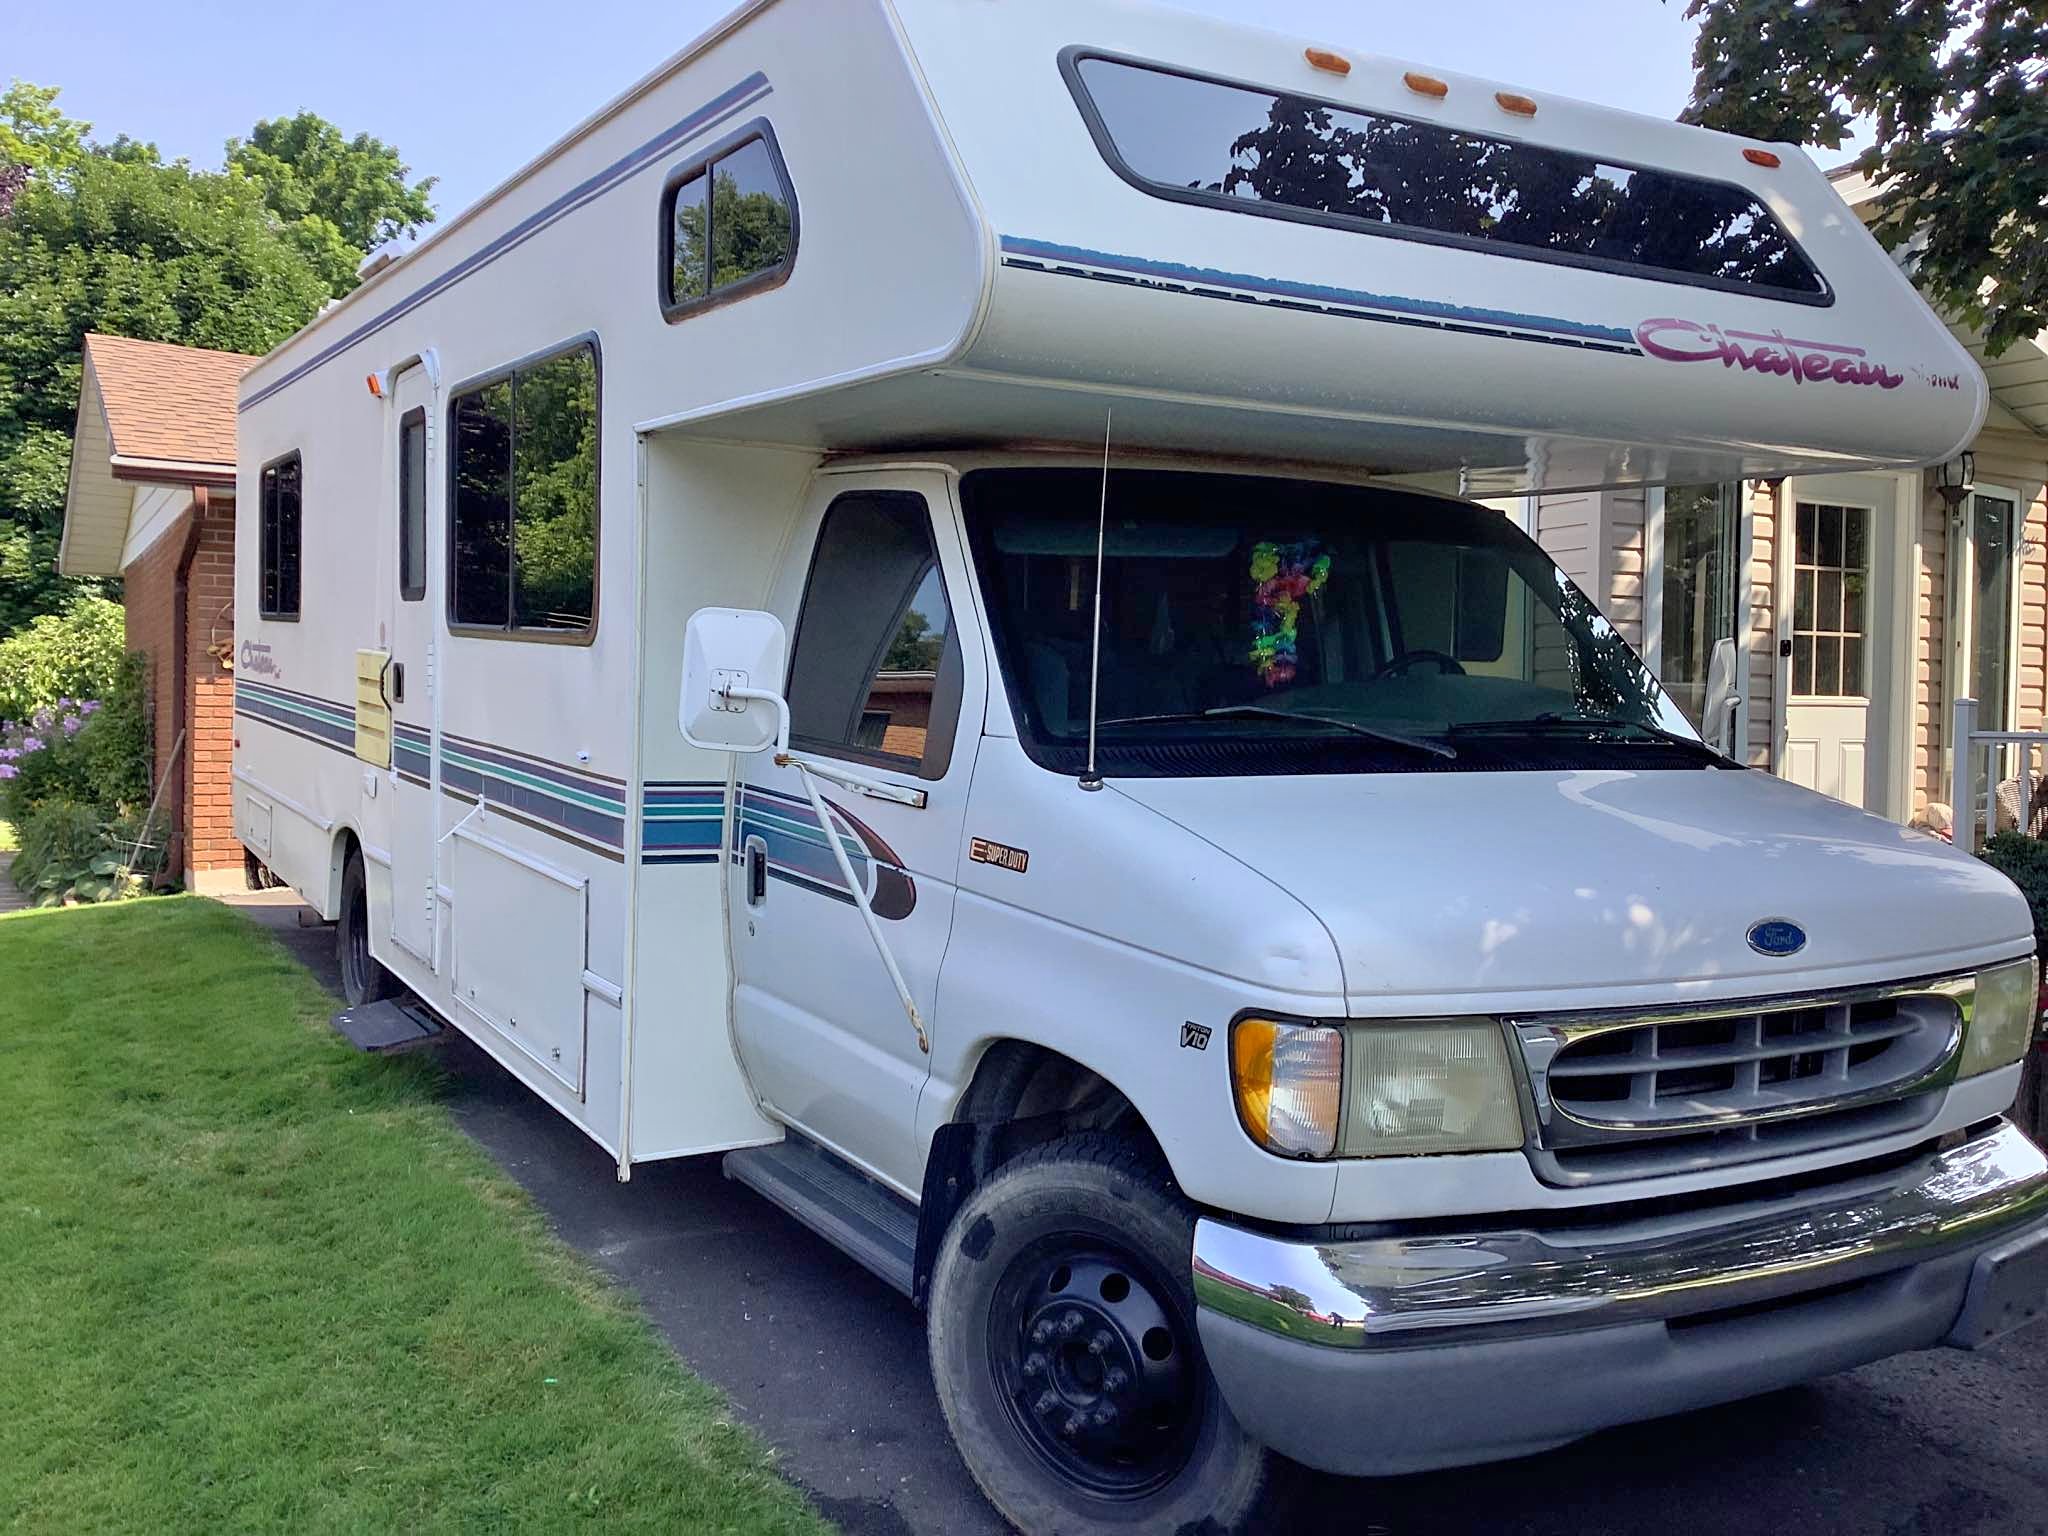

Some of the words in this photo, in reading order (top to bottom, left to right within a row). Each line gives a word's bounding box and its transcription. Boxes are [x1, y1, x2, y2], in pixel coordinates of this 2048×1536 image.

[1637, 317, 1904, 389] Chateau
[1008, 850, 1028, 871] DUTY
[1764, 926, 1794, 945] Ford
